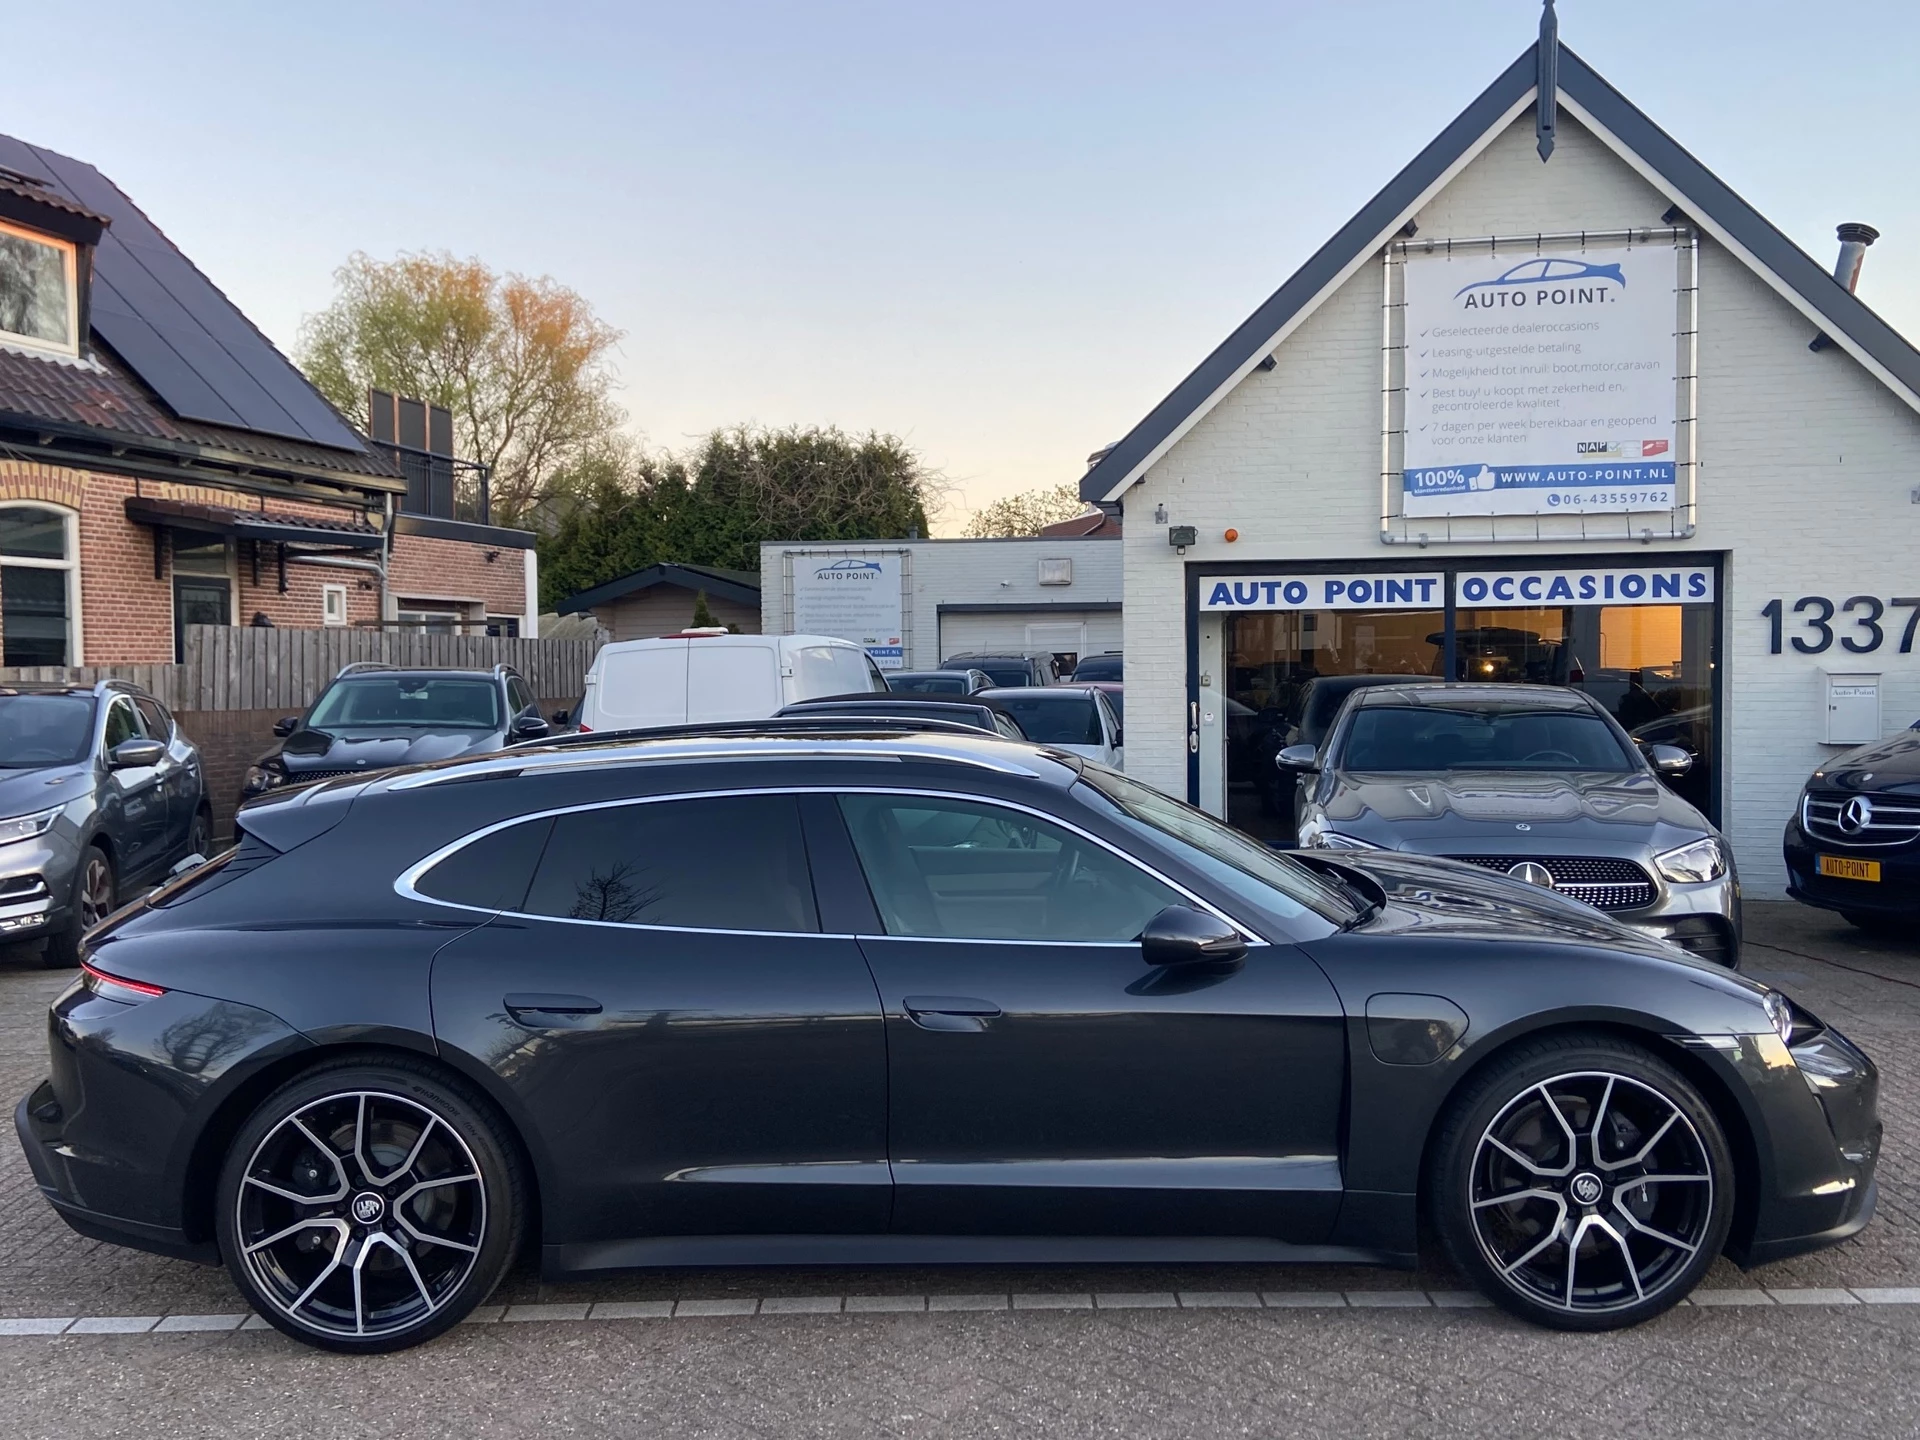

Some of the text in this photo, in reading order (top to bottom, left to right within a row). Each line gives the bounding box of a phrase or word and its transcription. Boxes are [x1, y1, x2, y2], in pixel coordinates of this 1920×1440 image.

[1464, 291, 1527, 310] AUTO
[1432, 321, 1599, 338] Geselecteerde dealeroccasions
[1432, 342, 1581, 358] Leasing-uitgestelde betaling
[1432, 365, 1499, 379] Mogelijkheid
[1502, 366, 1516, 375] tot
[1432, 388, 1456, 398] Best
[1459, 387, 1480, 399] buy!
[1484, 388, 1491, 396] u
[1494, 386, 1524, 397] koopt
[1528, 385, 1549, 394] met
[1552, 383, 1605, 394] zekerheid
[1432, 399, 1560, 414] gecontroleerde kwaliteit
[1433, 415, 1657, 433] 7 dagen per week bereikbaar en geopend
[1432, 434, 1527, 445] voor onze klanten
[1577, 441, 1607, 453] NAP
[1415, 469, 1465, 487] 100%
[1501, 468, 1668, 483] WWW.AUTO-POINT.NL
[1564, 492, 1668, 505] 06-43559762
[1208, 572, 1707, 606] AUTO POINT OCCASIONS
[1761, 595, 1920, 655] 1337
[1826, 859, 1870, 877] AUTO-POINT
